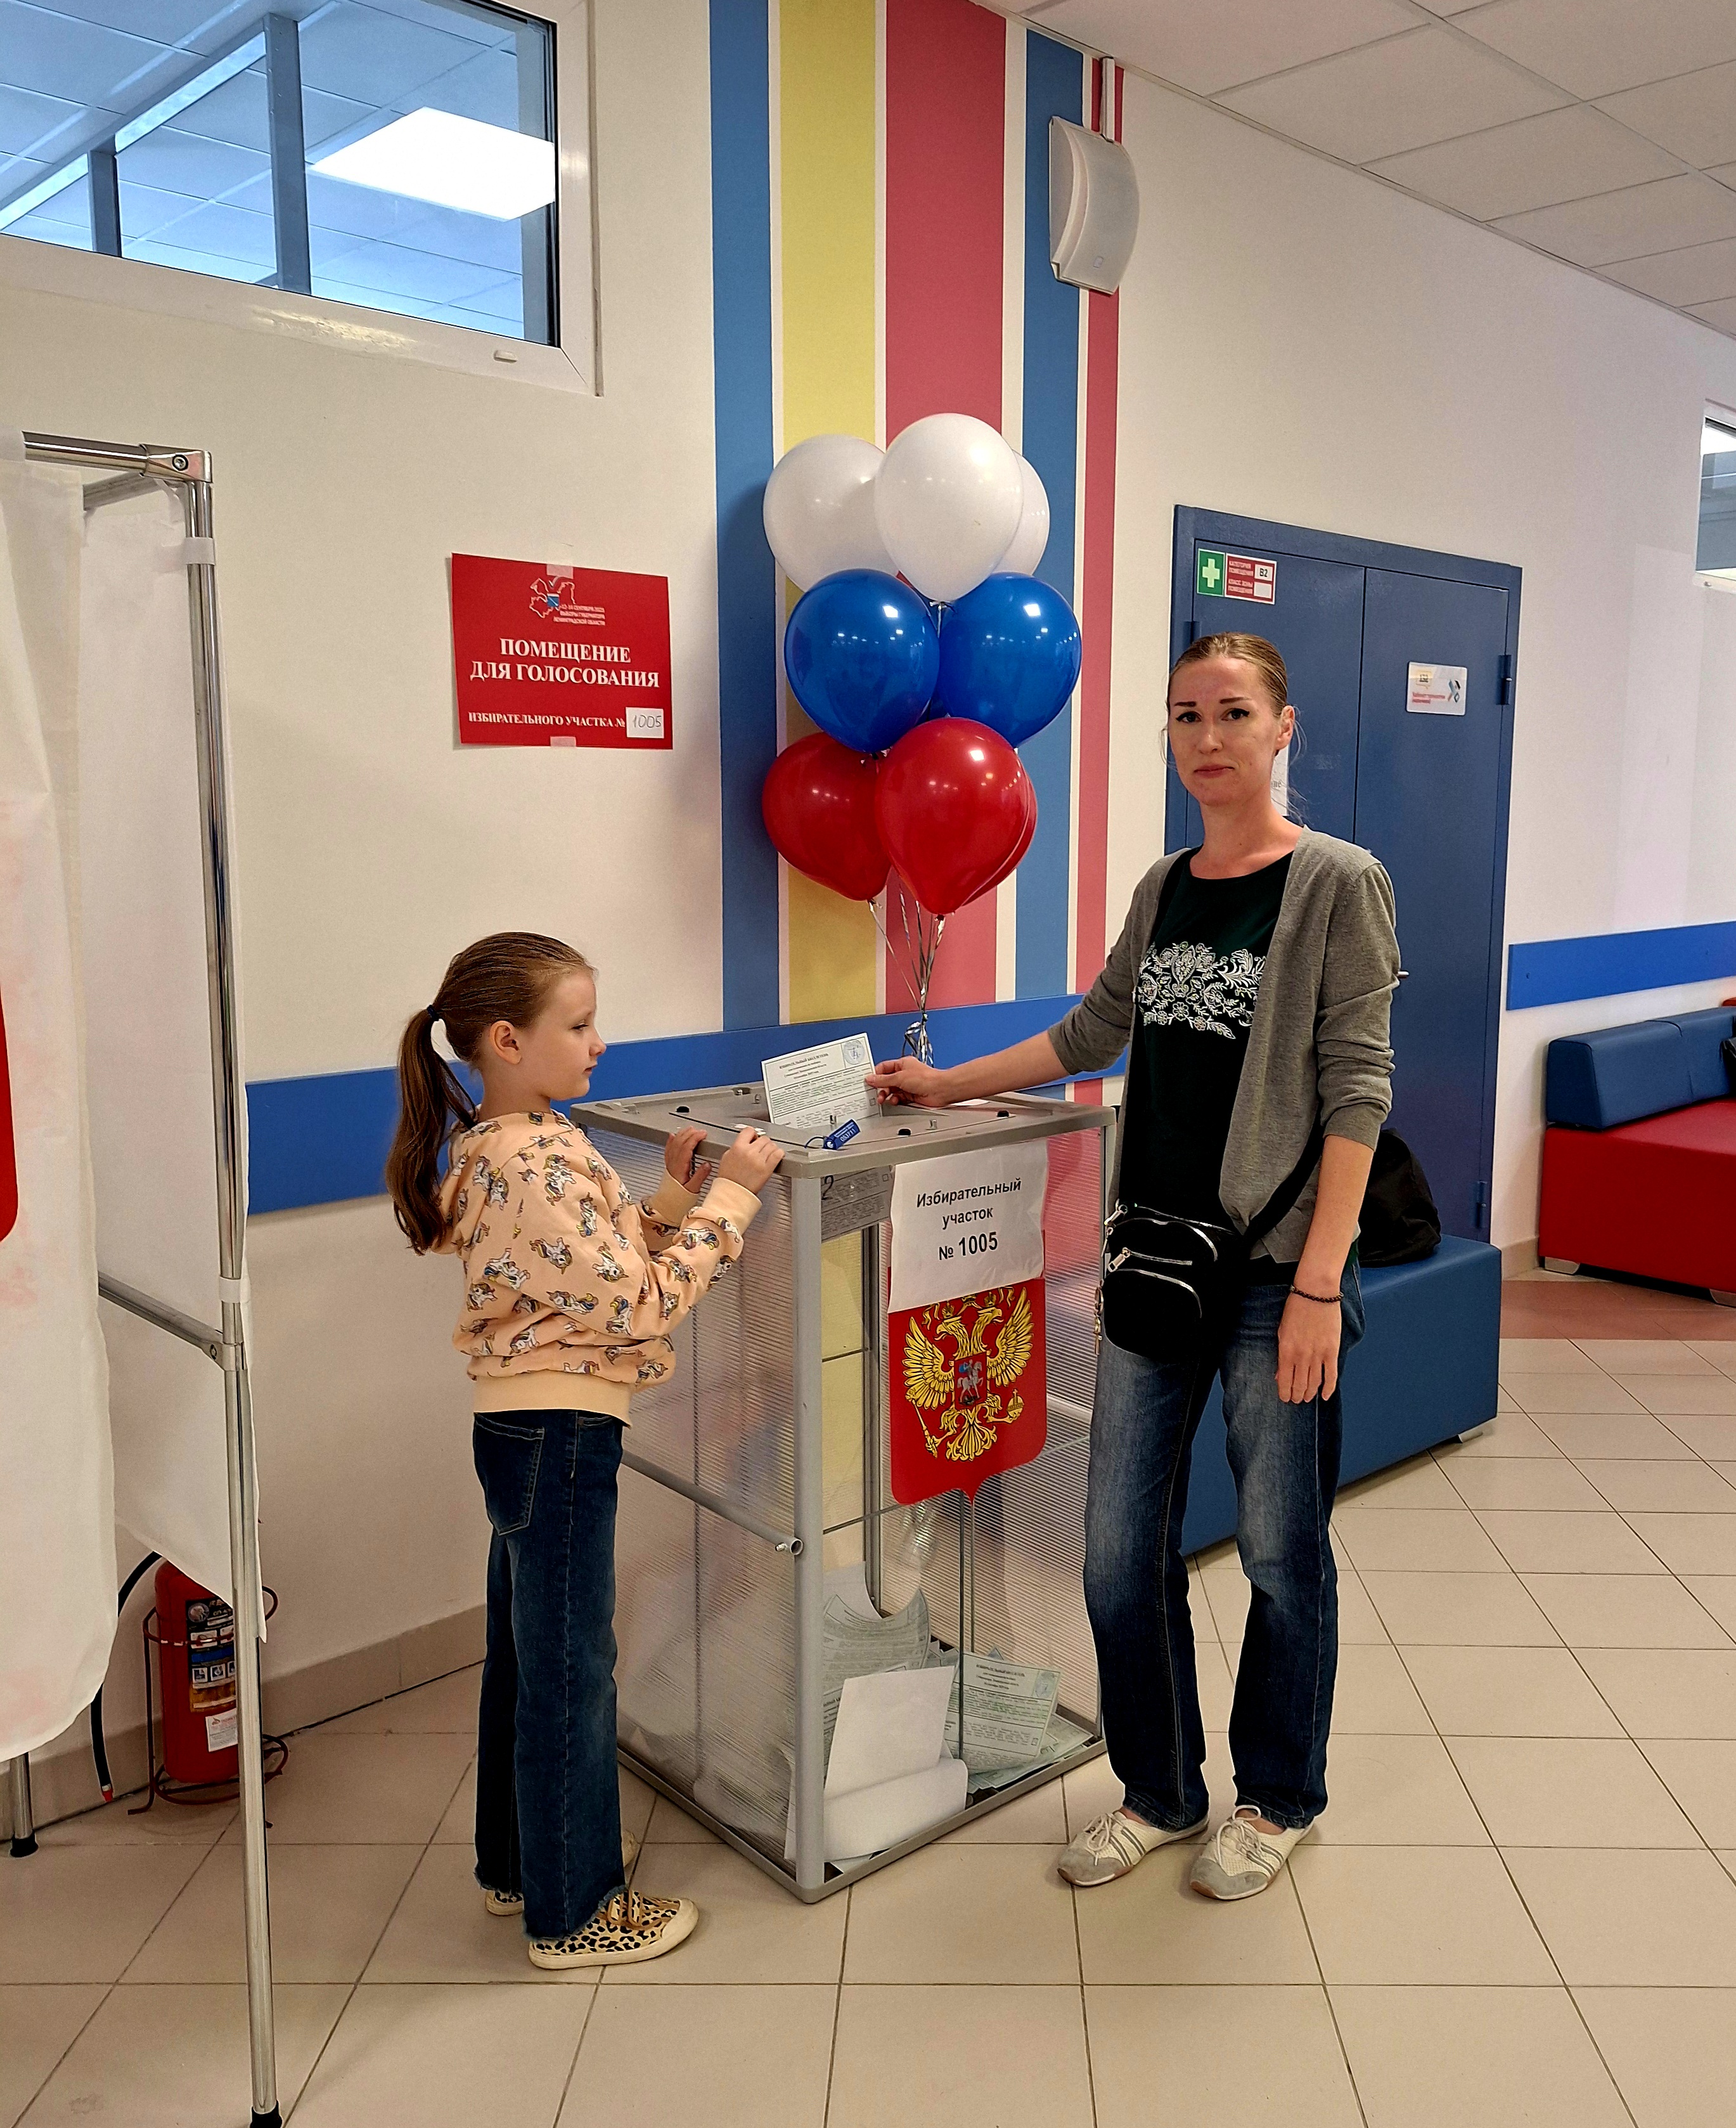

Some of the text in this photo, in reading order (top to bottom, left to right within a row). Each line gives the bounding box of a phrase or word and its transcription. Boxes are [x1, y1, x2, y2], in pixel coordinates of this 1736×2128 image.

[499, 638, 631, 663] ПОМЕЩЕНИЕ
[470, 661, 660, 688] ДЛЯ ГОЛОСОВАНИЯ
[468, 711, 563, 725] ИЗБИРАТЕЛЬНОГО
[565, 716, 613, 727] УЧАСТКА
[632, 714, 662, 728] 1005
[916, 1178, 1022, 1208] Избирательный
[942, 1206, 993, 1230] участок
[938, 1232, 998, 1261] № 1005
